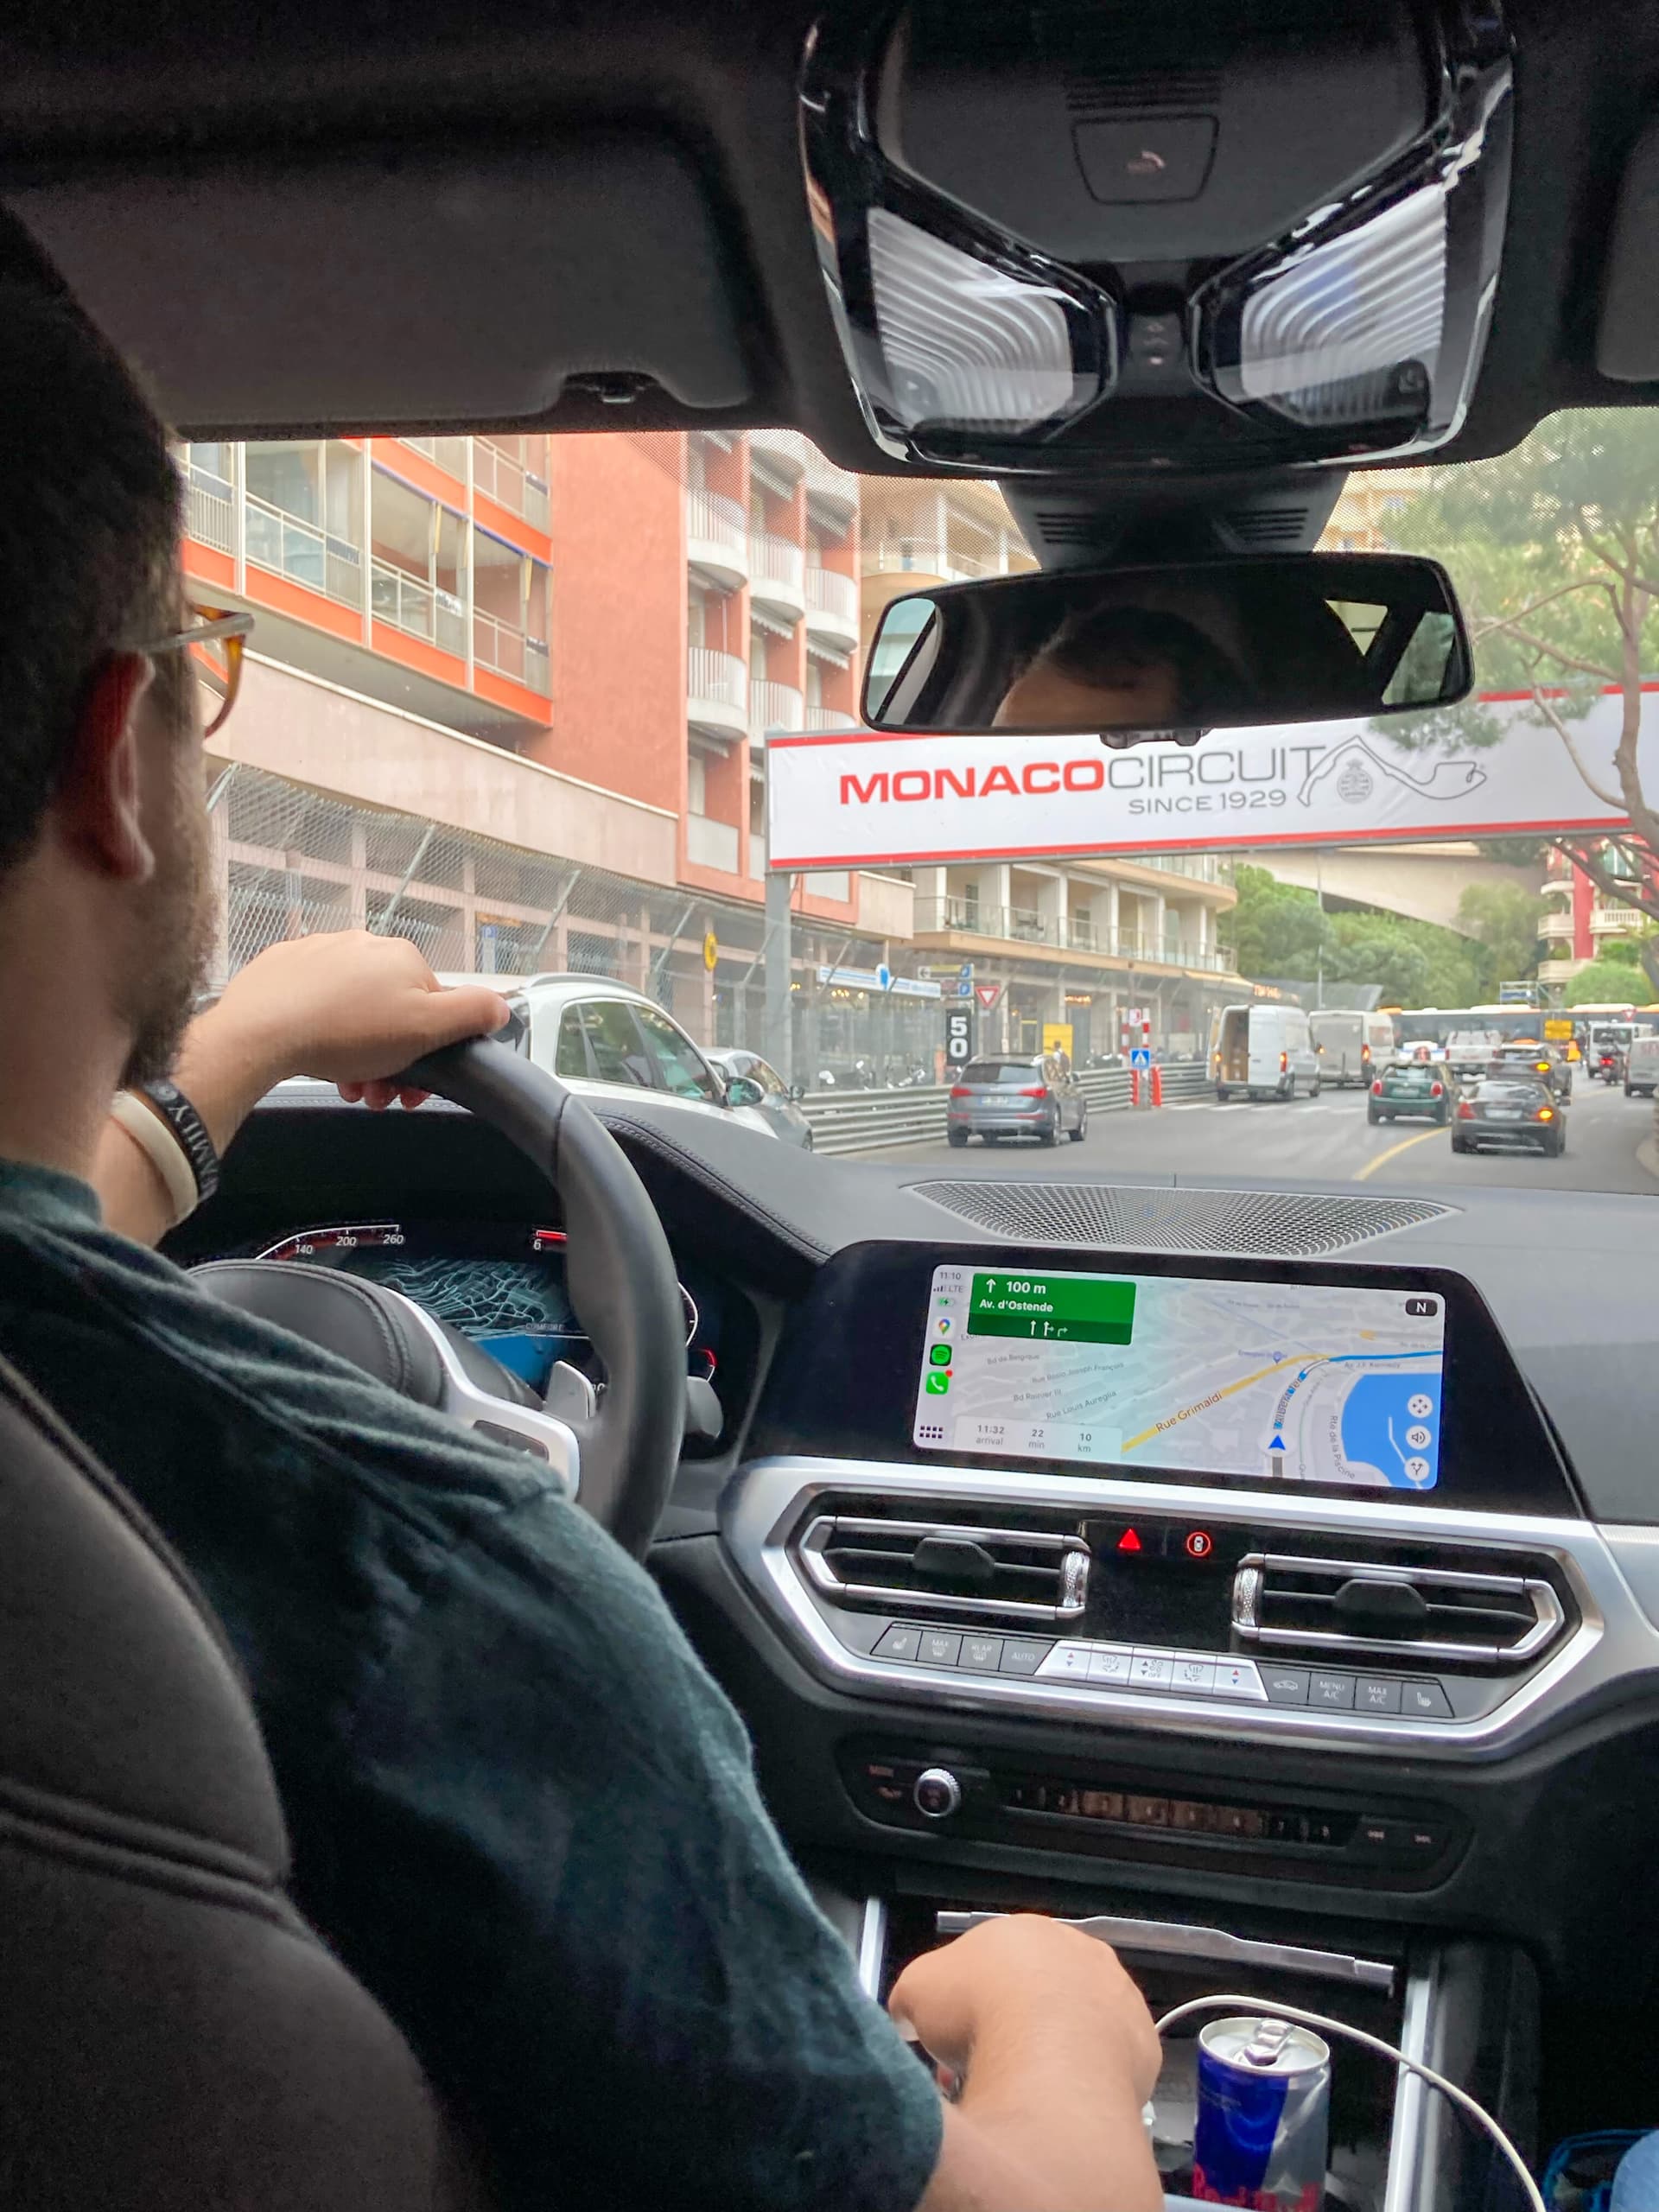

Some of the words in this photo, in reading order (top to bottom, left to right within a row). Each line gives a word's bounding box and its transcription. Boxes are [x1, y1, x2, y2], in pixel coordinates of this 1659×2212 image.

[1128, 795, 1211, 815] SINCE
[1219, 789, 1287, 809] 1929
[335, 1236, 357, 1247] 200
[383, 1234, 404, 1245] 260
[532, 1238, 542, 1251] 6
[295, 1244, 314, 1255] 140
[1006, 1281, 1031, 1294] 100
[1033, 1283, 1047, 1294] m
[979, 1299, 995, 1309] Av.
[997, 1300, 1054, 1313] d'Ostende
[1415, 1302, 1427, 1313] N
[1046, 1410, 1062, 1421] Rue
[1154, 1416, 1177, 1433] Rue
[1177, 1390, 1224, 1422] Grimaldi
[976, 1424, 1005, 1434] 11:32
[1031, 1428, 1045, 1438] 22
[976, 1435, 1004, 1446] arrival
[1079, 1433, 1092, 1441] 10
[1027, 1440, 1046, 1450] min
[1077, 1443, 1092, 1453] km
[1011, 1651, 1036, 1662] AUTO
